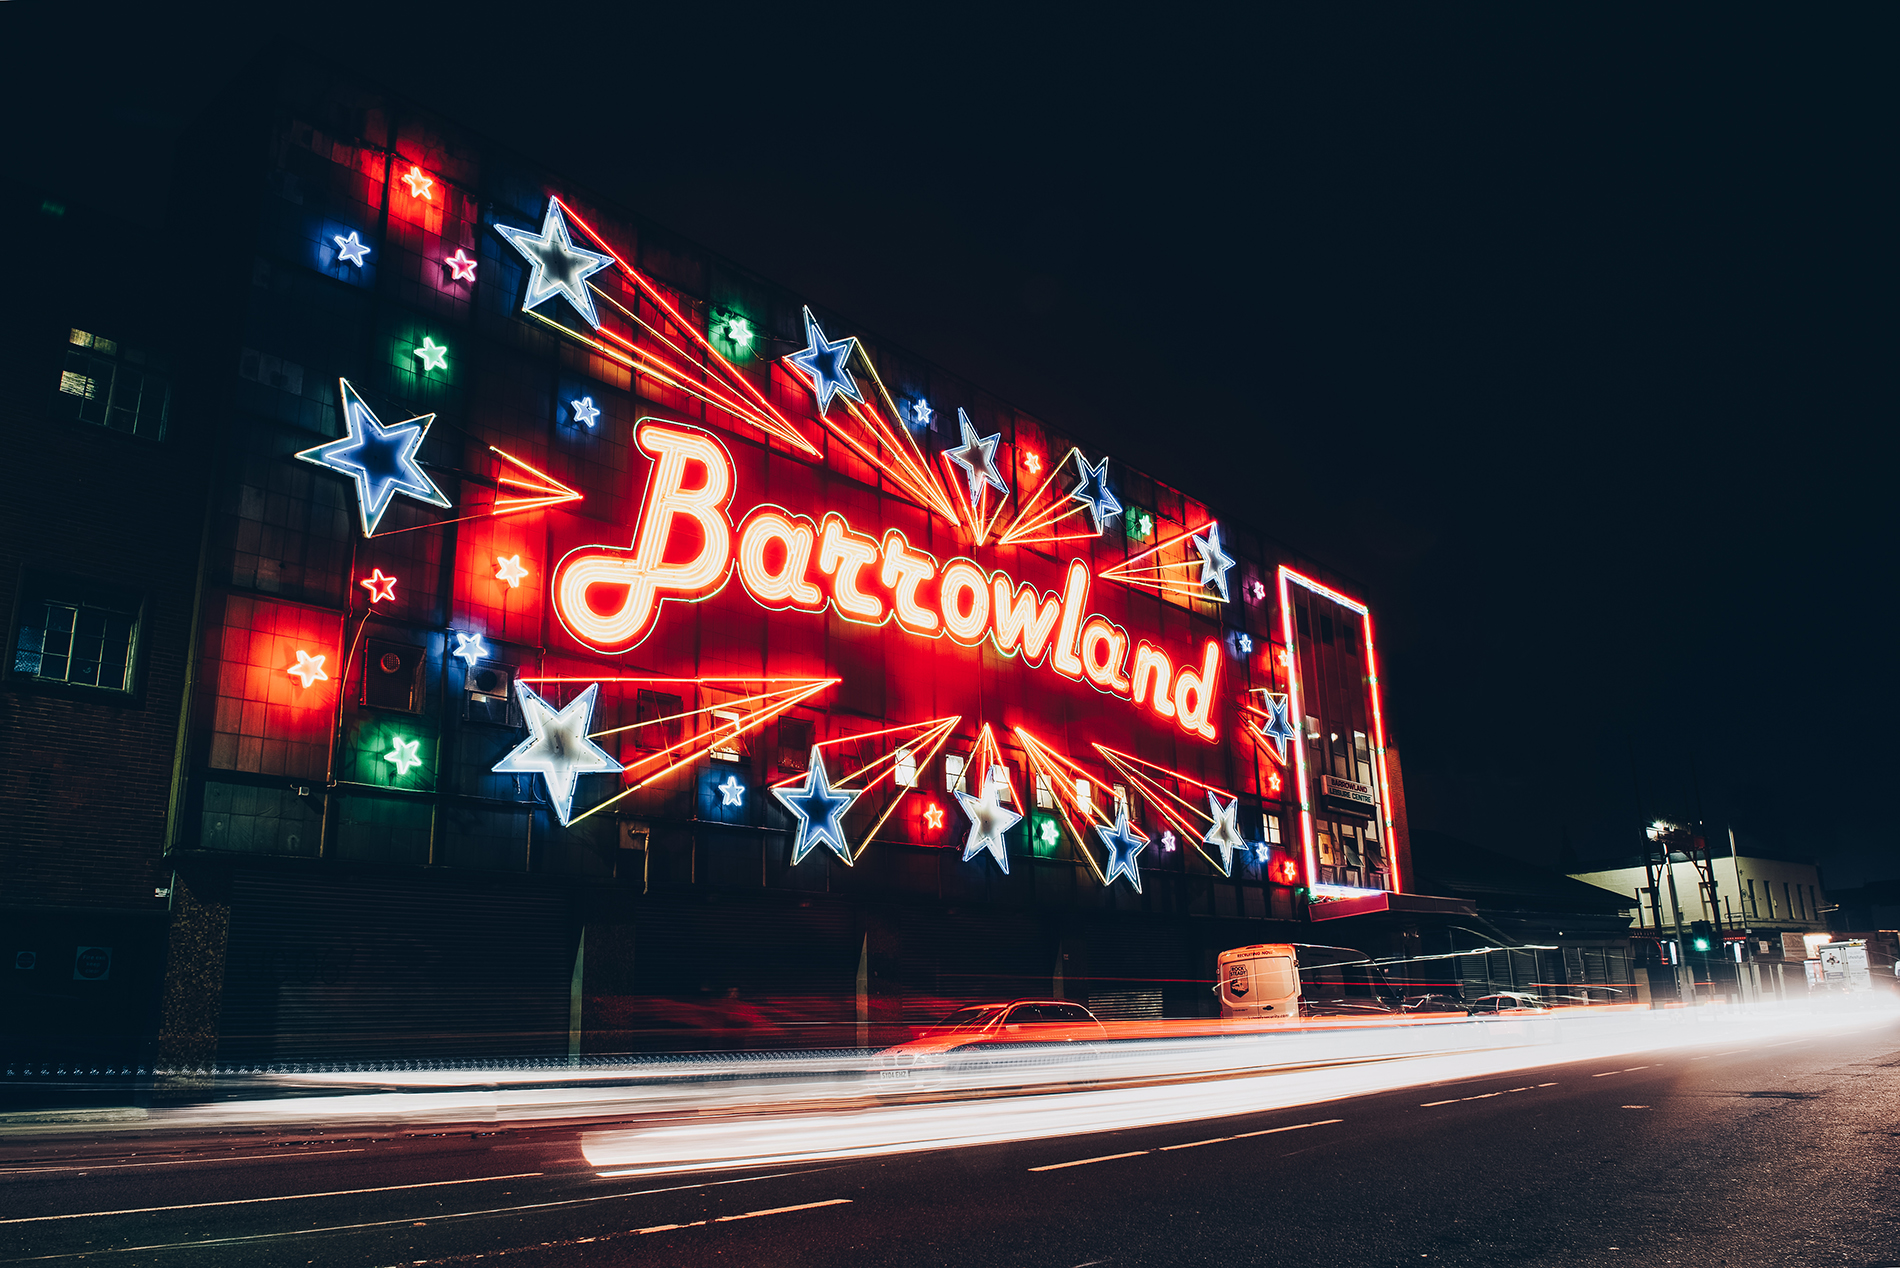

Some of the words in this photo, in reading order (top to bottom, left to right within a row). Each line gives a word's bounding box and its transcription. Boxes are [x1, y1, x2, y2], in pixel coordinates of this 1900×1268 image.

[551, 416, 1220, 745] Barrowland
[1331, 778, 1368, 793] BARROWLAND
[1329, 788, 1351, 799] LEISURE
[1352, 792, 1372, 804] CENTRE
